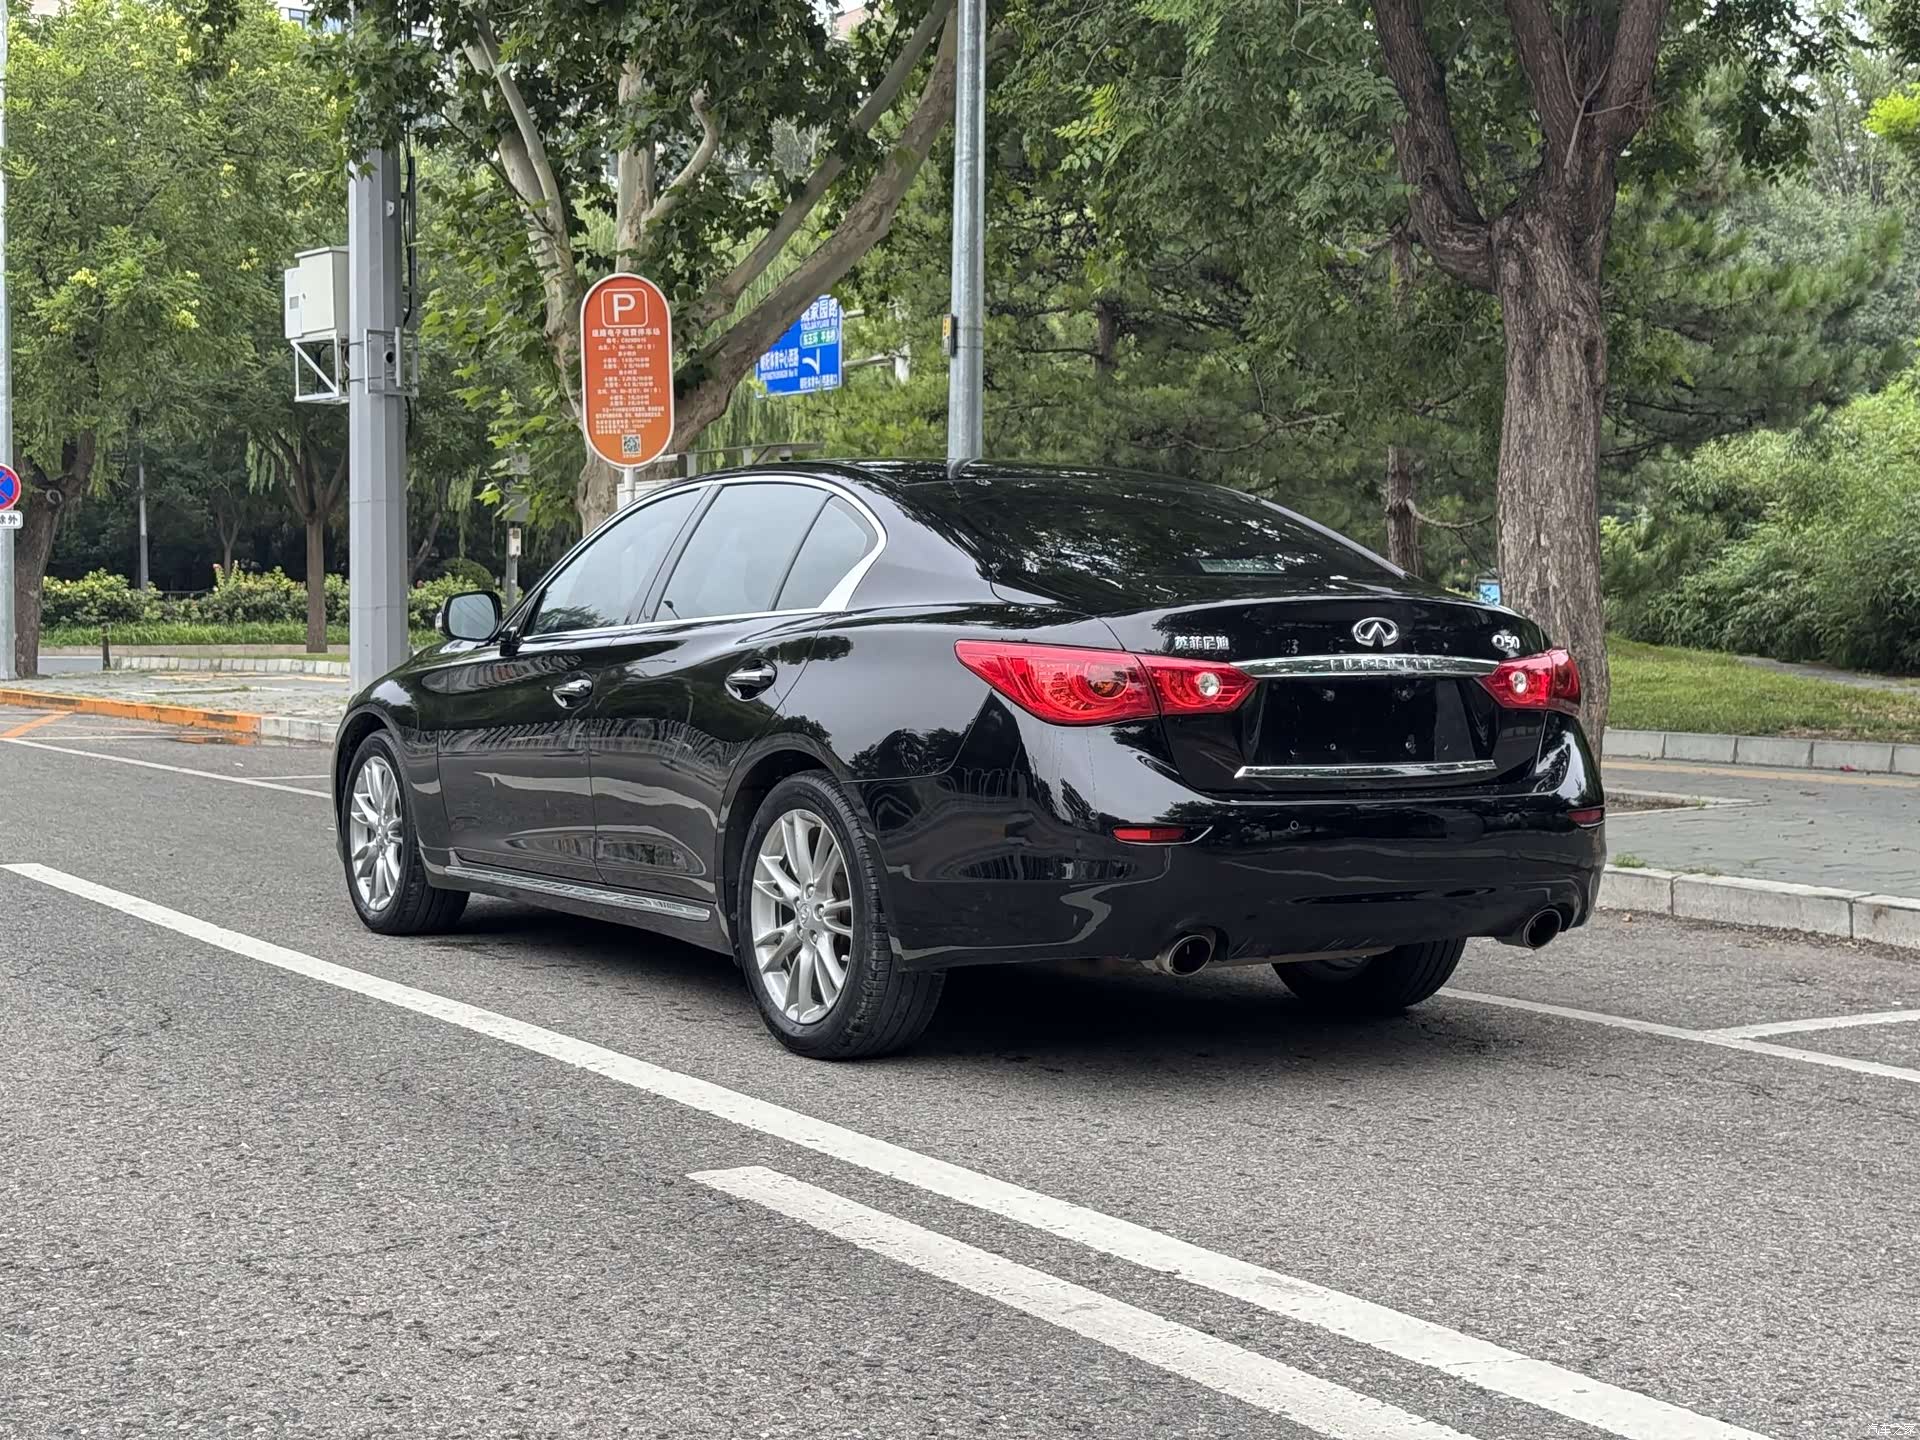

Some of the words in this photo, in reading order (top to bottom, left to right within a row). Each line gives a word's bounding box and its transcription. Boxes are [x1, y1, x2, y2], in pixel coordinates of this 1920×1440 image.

[613, 293, 636, 323] P
[1174, 635, 1230, 650] 英菲尼迪
[1491, 634, 1520, 651] Q50
